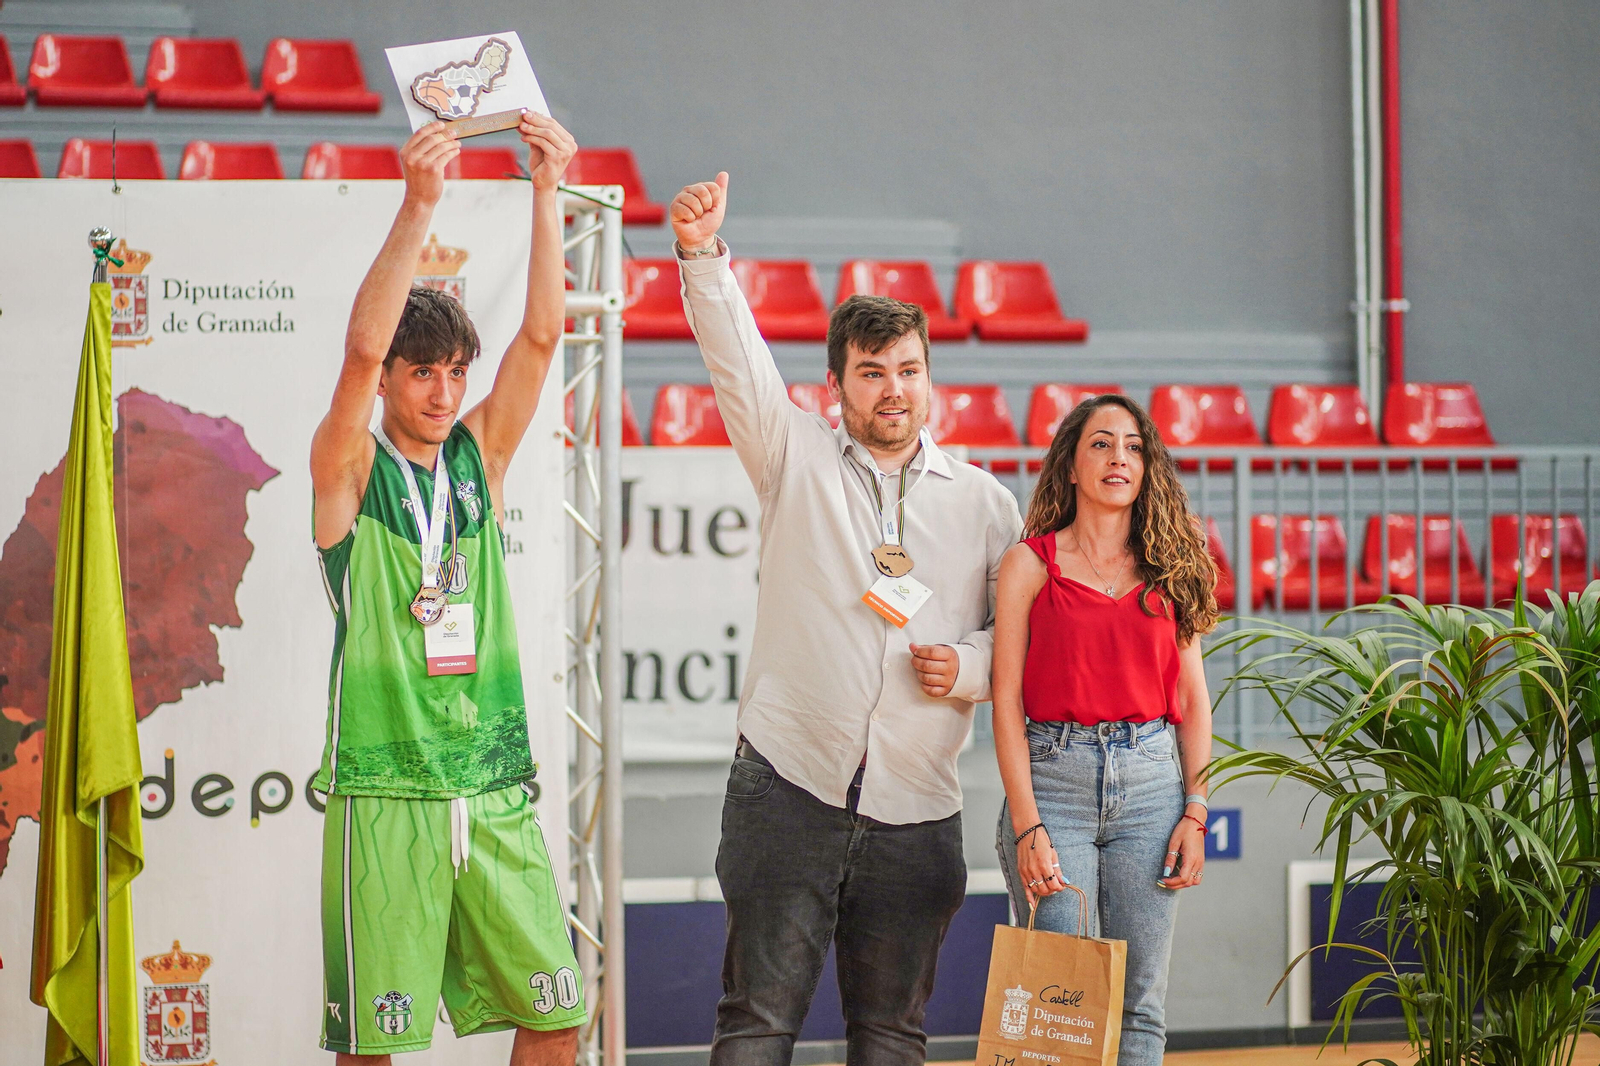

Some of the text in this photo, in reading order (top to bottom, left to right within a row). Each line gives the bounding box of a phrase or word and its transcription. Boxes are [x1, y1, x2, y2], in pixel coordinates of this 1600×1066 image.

[161, 278, 295, 306] Diputación
[162, 310, 295, 333] de Granada
[621, 477, 761, 561] Jue
[1209, 815, 1229, 852] 1
[528, 966, 580, 1016] 30
[1039, 984, 1085, 1008] Castell
[1033, 1007, 1095, 1029] Diputación
[1030, 1024, 1093, 1046] de Granada
[1021, 1050, 1061, 1063] DEPORTES
